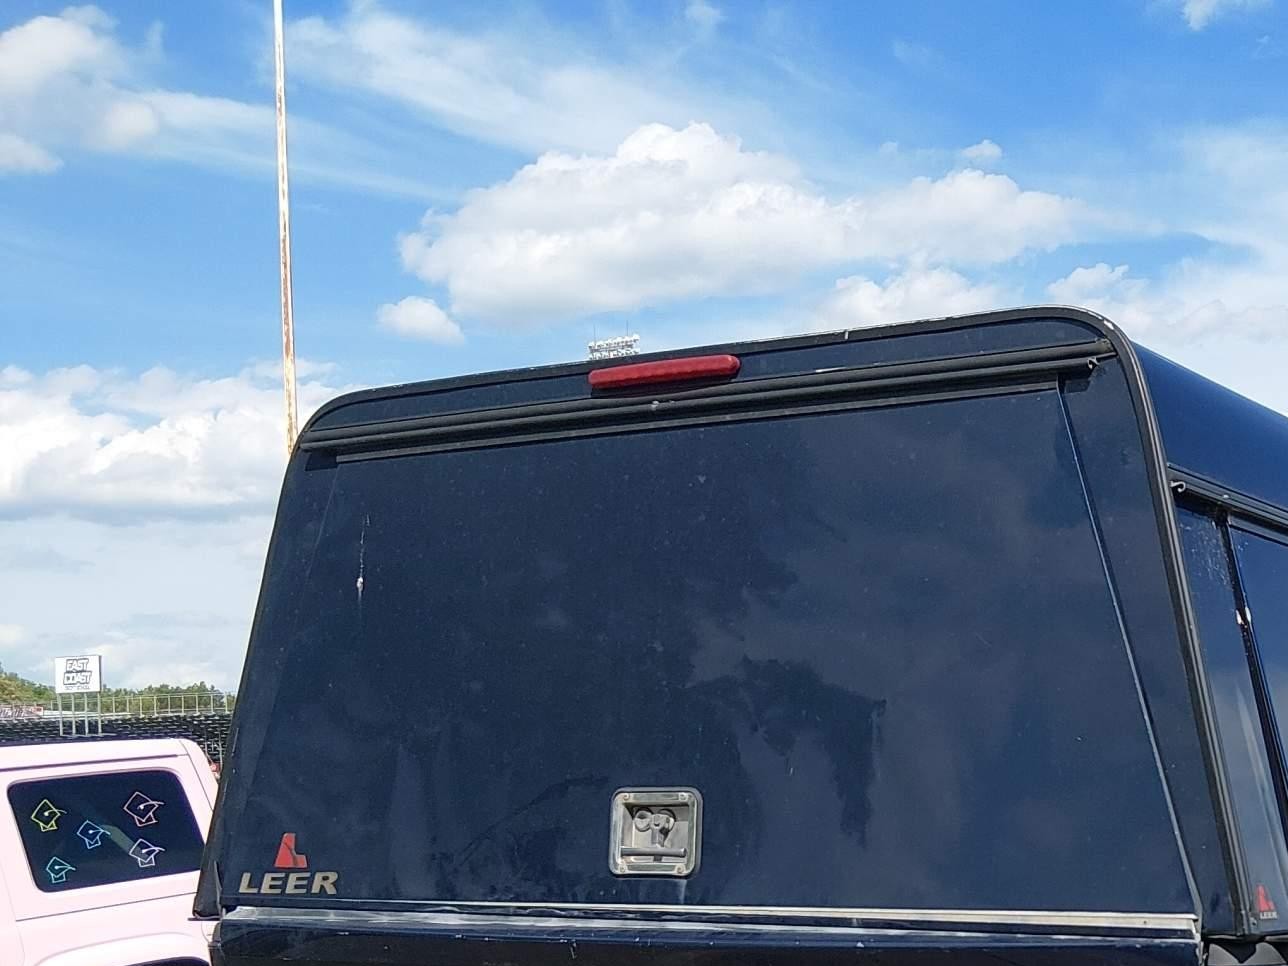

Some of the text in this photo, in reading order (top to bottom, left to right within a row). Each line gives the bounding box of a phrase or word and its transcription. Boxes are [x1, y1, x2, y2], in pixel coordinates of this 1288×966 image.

[65, 657, 90, 671] EAST
[63, 671, 92, 685] COAST
[239, 871, 338, 895] LEER
